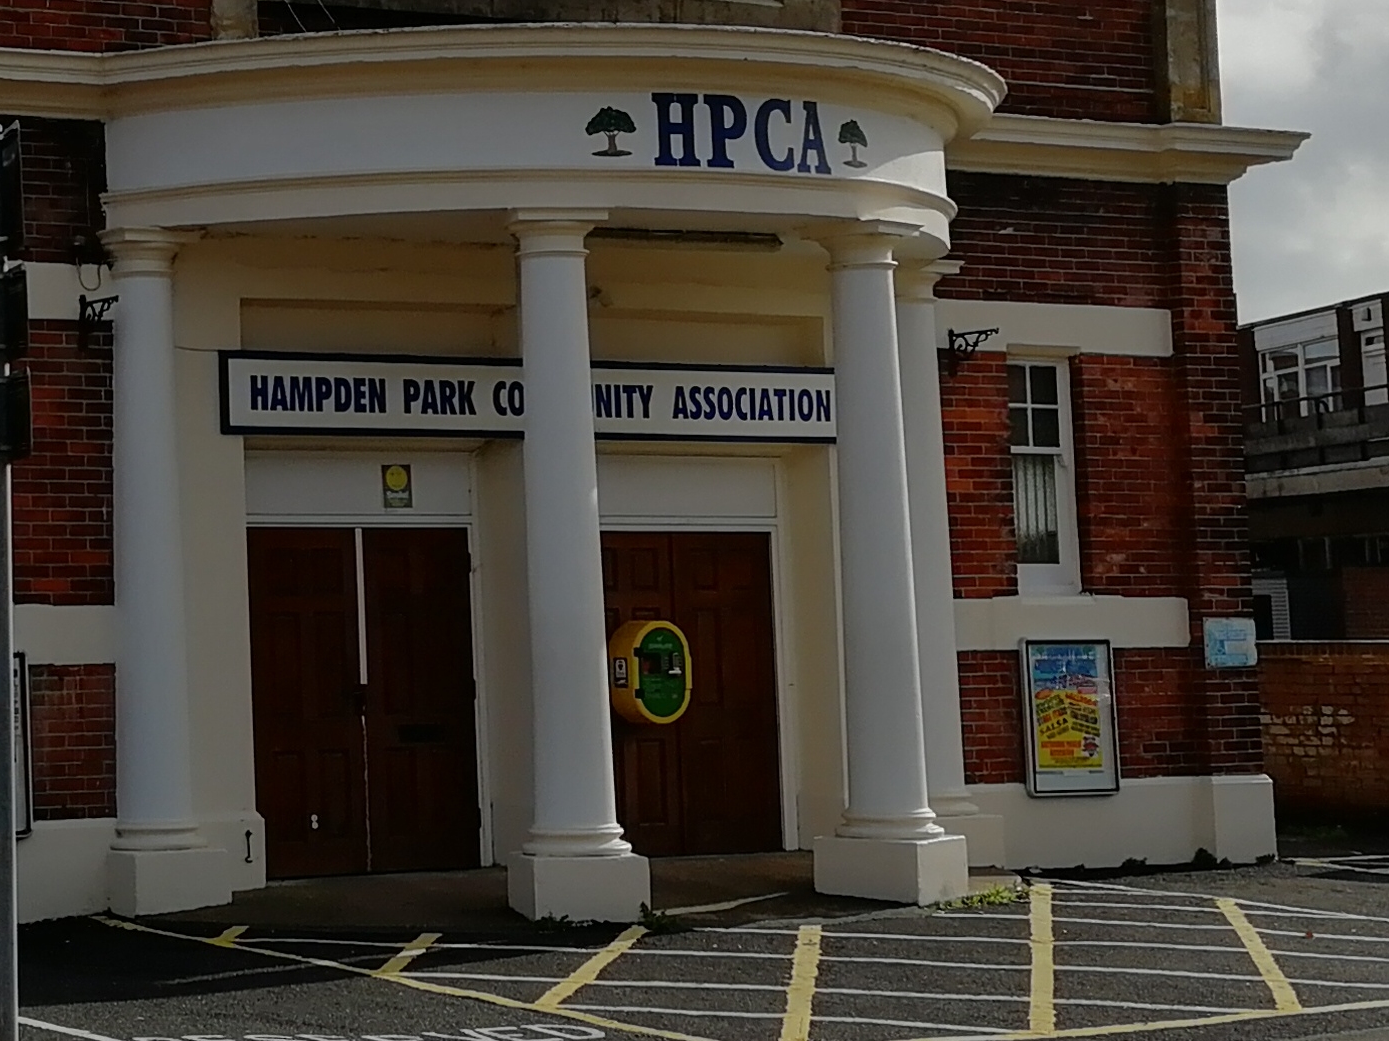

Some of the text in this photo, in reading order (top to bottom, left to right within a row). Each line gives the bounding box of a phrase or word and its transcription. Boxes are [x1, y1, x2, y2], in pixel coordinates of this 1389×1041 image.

[652, 92, 832, 175] HPCA
[250, 375, 832, 422] HAMPDEN PARK CONITY ASSOCIATION
[1038, 717, 1069, 736] SALSA
